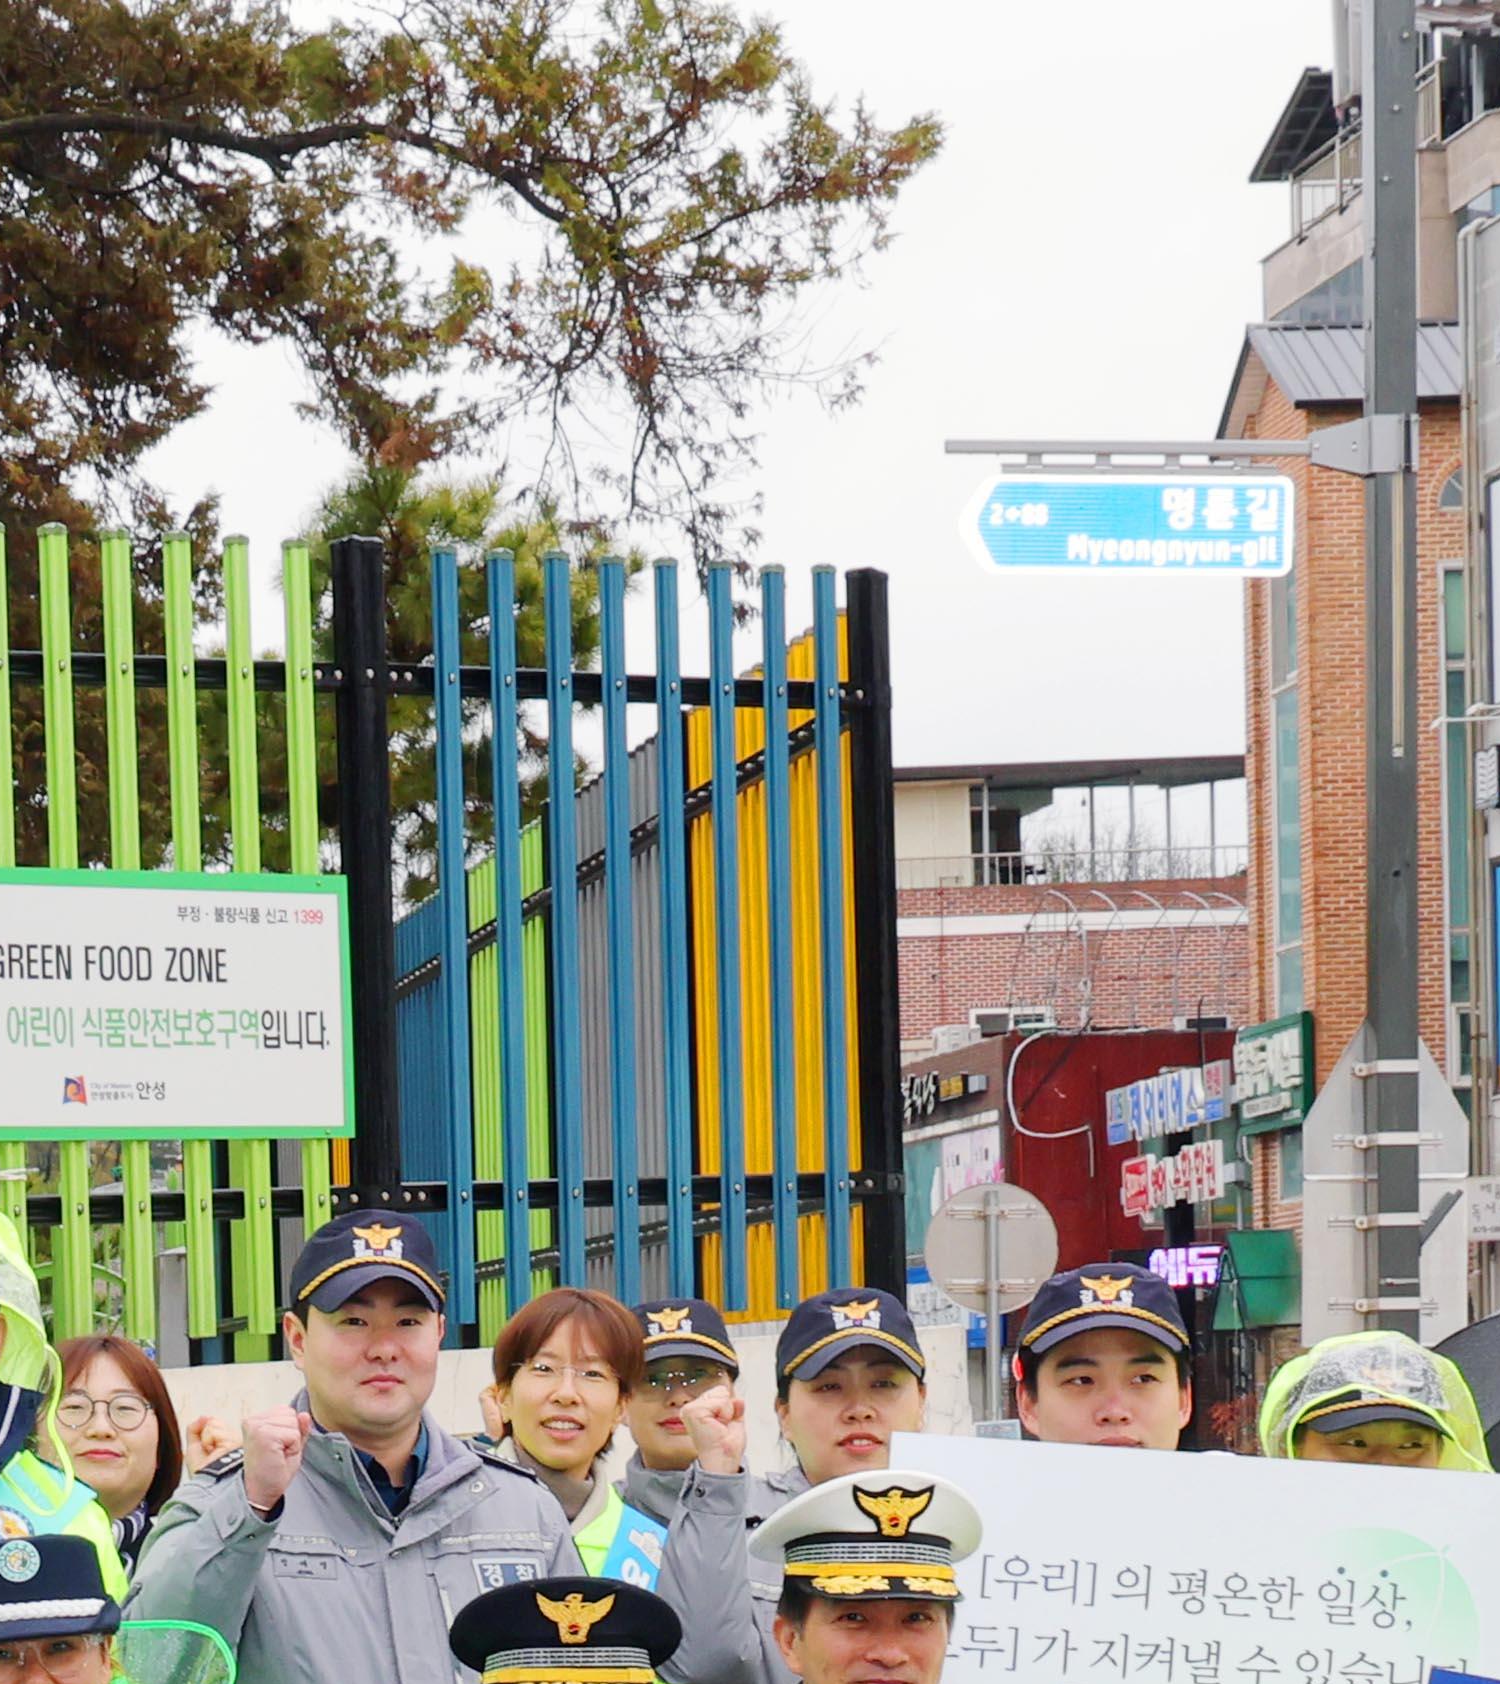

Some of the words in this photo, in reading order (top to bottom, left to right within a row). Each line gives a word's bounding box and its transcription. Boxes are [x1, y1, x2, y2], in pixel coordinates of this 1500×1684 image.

[1066, 532, 1278, 567] Myeongnyun-gil
[264, 908, 290, 926] 신고
[292, 909, 325, 926] 1399
[83, 944, 153, 983] FOOD
[164, 946, 228, 984] ZONE
[6, 1005, 76, 1048] 어린이
[135, 1081, 167, 1101] 안성
[1110, 1564, 1153, 1610] 의
[1167, 1568, 1304, 1622] 평온한
[1032, 1628, 1079, 1675] 가
